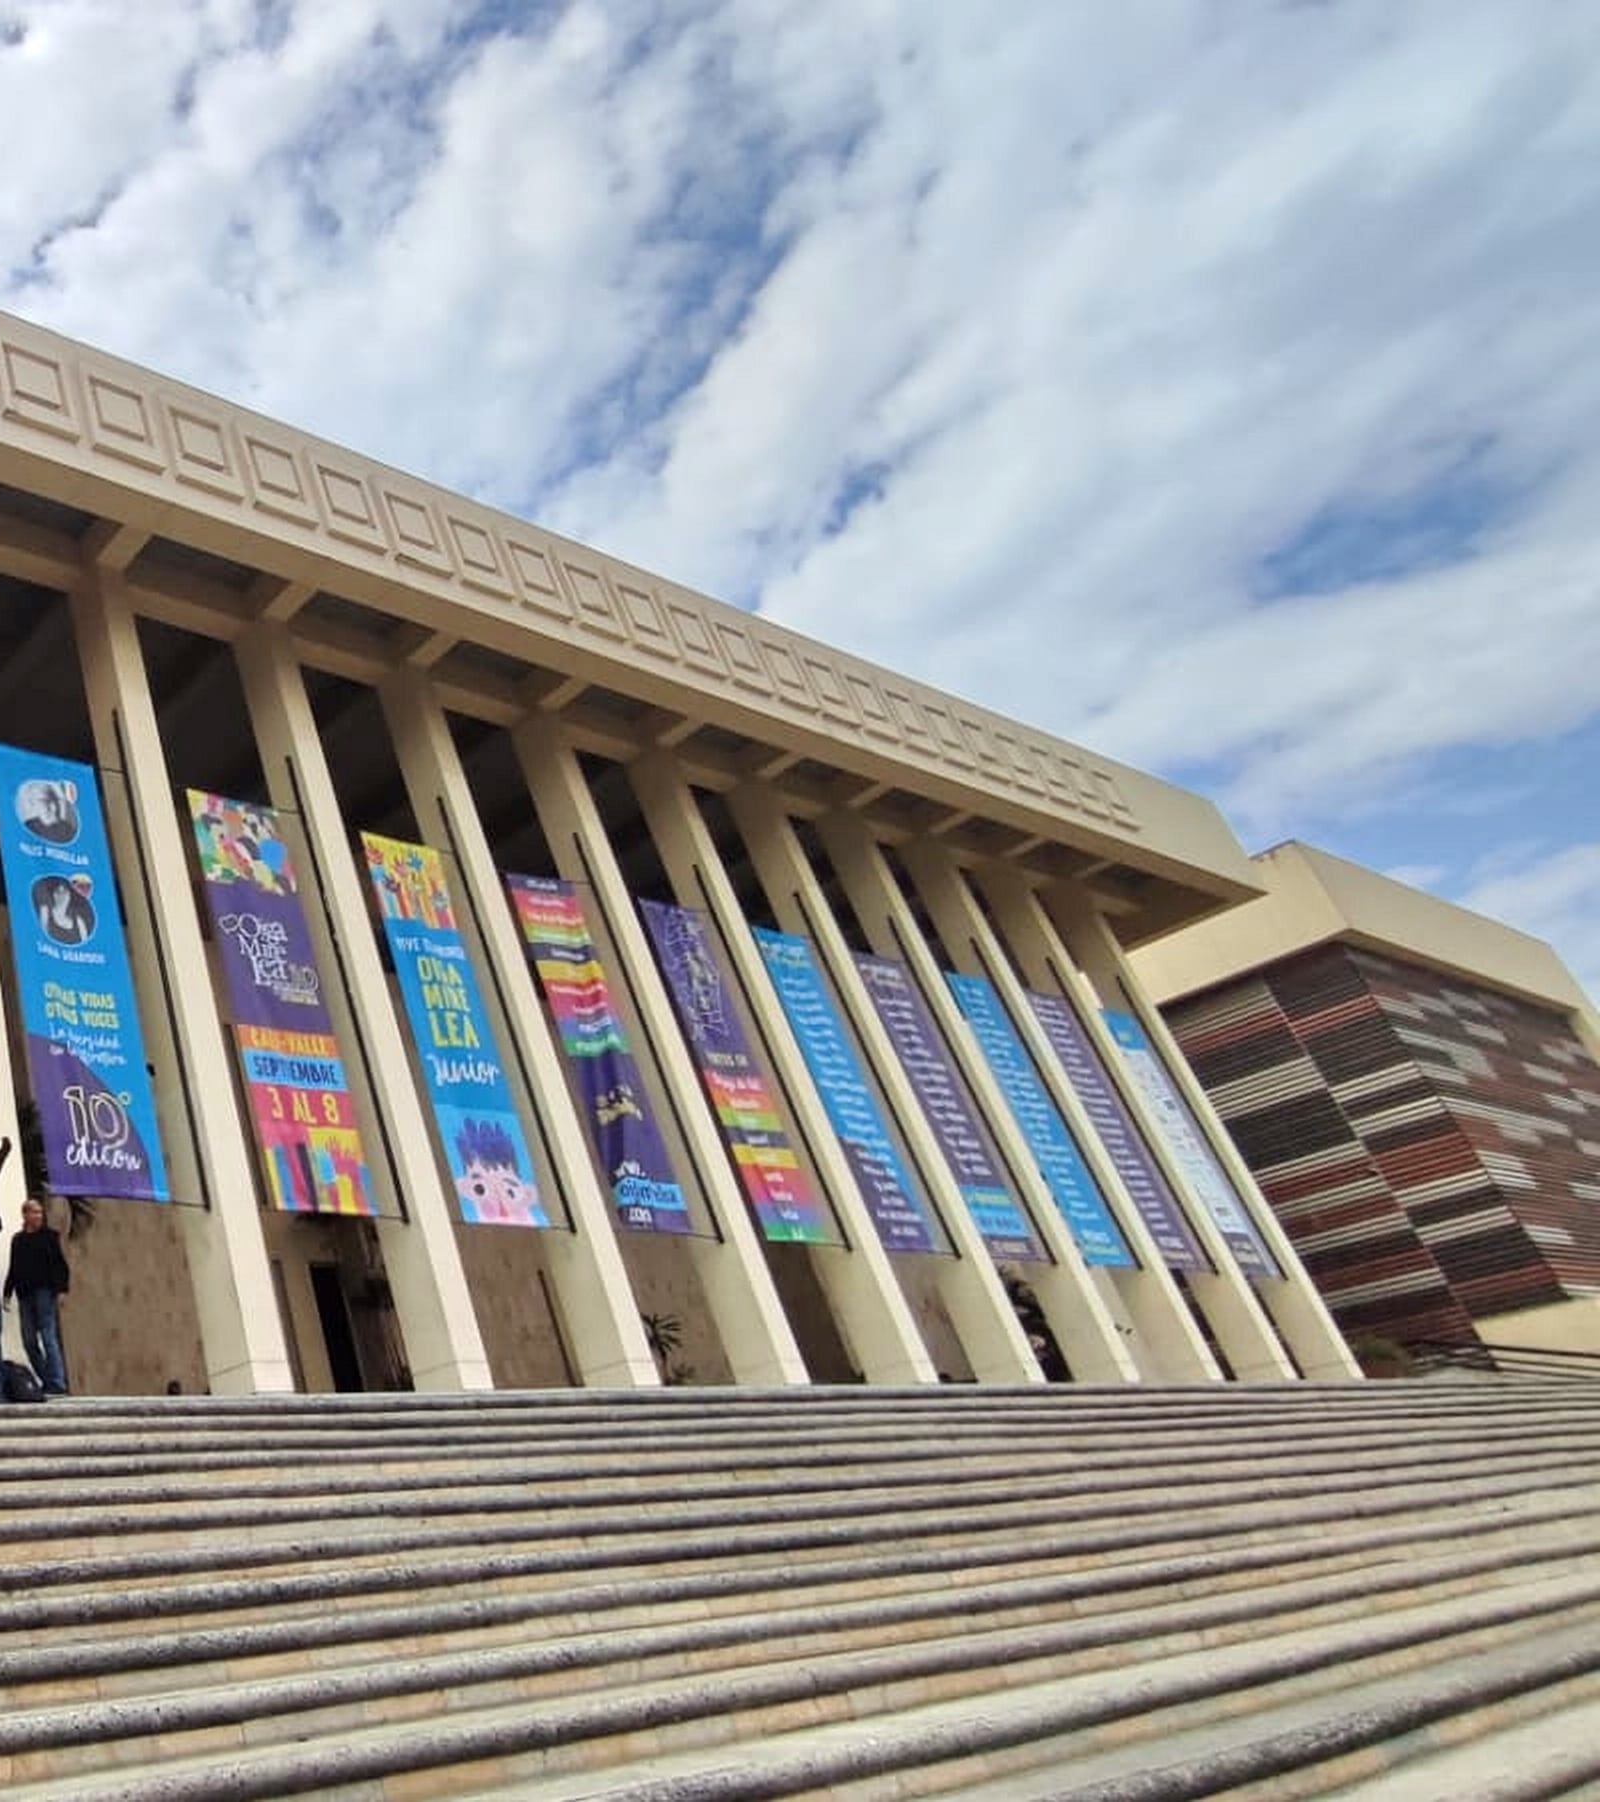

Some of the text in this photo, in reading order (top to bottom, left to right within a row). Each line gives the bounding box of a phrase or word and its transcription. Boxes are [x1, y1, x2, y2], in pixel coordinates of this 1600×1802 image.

[428, 1010, 481, 1048] LEA
[253, 1055, 339, 1085] SEPTIEMBRE
[426, 1053, 500, 1087] Junior
[266, 1087, 340, 1125] 3 AL 8
